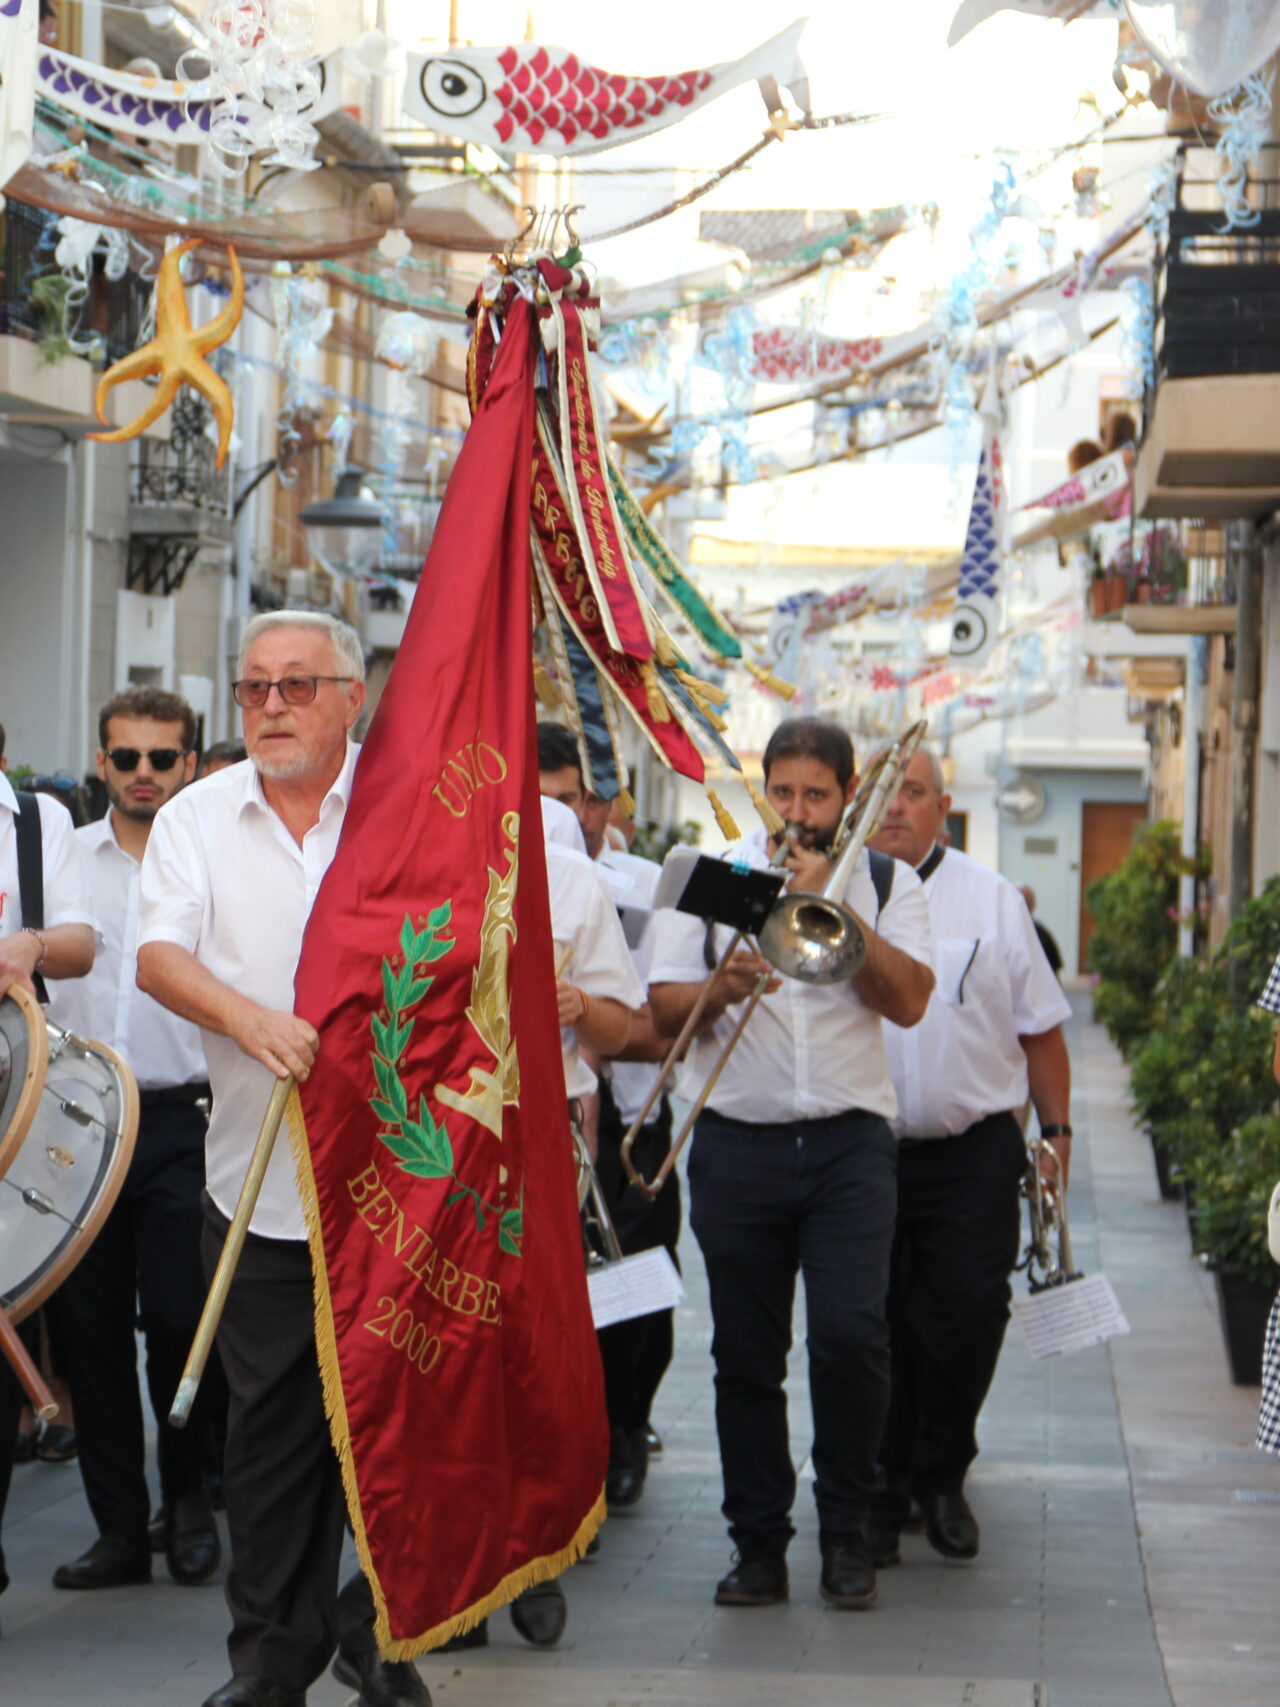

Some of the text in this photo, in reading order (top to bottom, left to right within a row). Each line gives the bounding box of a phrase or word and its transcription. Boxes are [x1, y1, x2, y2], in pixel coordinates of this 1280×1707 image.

[571, 357, 591, 456] Ajuntament
[580, 459, 596, 481] de
[586, 484, 617, 578] Beniarbeig
[432, 729, 507, 817] UNIÓ
[363, 1296, 441, 1375] 2000
